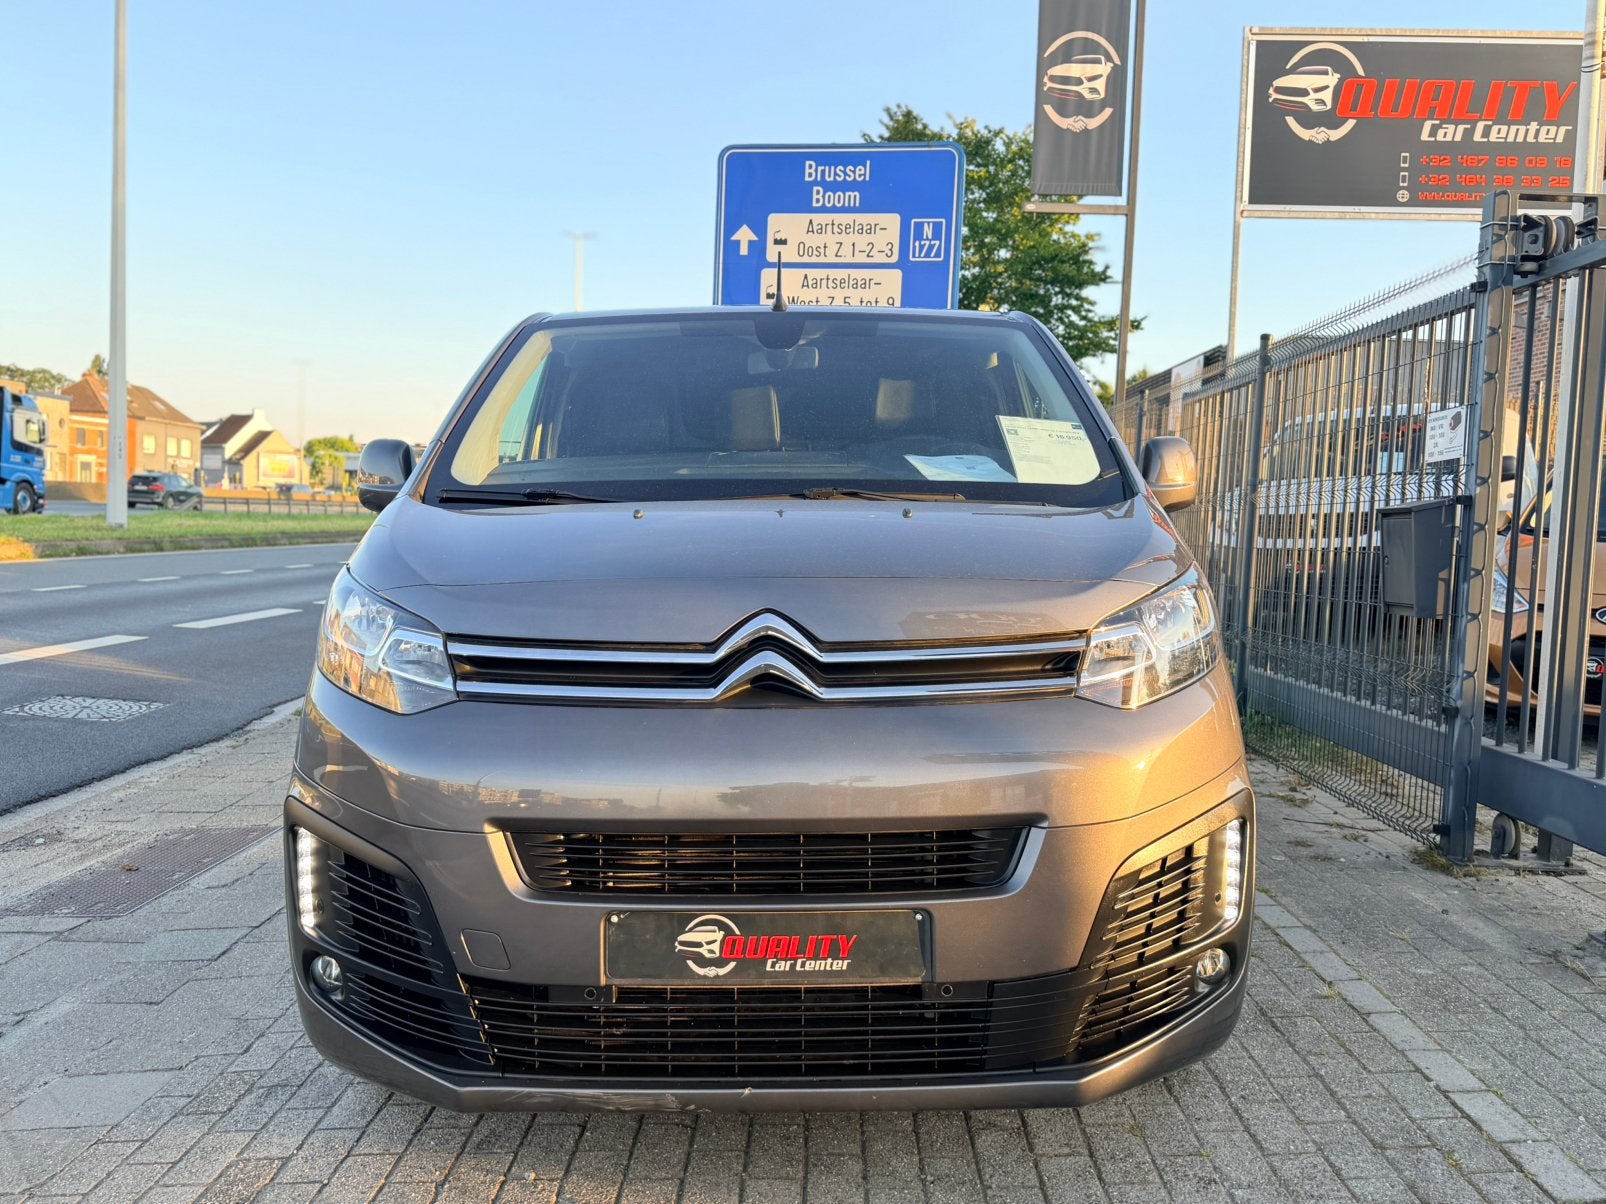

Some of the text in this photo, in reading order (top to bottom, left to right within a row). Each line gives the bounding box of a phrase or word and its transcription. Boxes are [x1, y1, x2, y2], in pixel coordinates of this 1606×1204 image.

[1336, 78, 1577, 120] QUALITY
[1420, 120, 1573, 143] Car Center
[1419, 155, 1452, 167] +32
[804, 160, 871, 181] Brussel
[1418, 174, 1450, 186] +32
[1521, 175, 1543, 188] 33
[1548, 176, 1571, 188] 25
[812, 187, 860, 207] Boom
[806, 219, 887, 235] Aartselaar-
[923, 222, 934, 239] N
[797, 242, 894, 258] Oost Z. 1-2-3
[914, 241, 940, 257] 177
[801, 273, 882, 290] Aartselaar-
[722, 934, 857, 959] QUALITY
[766, 958, 851, 971] Car Center
